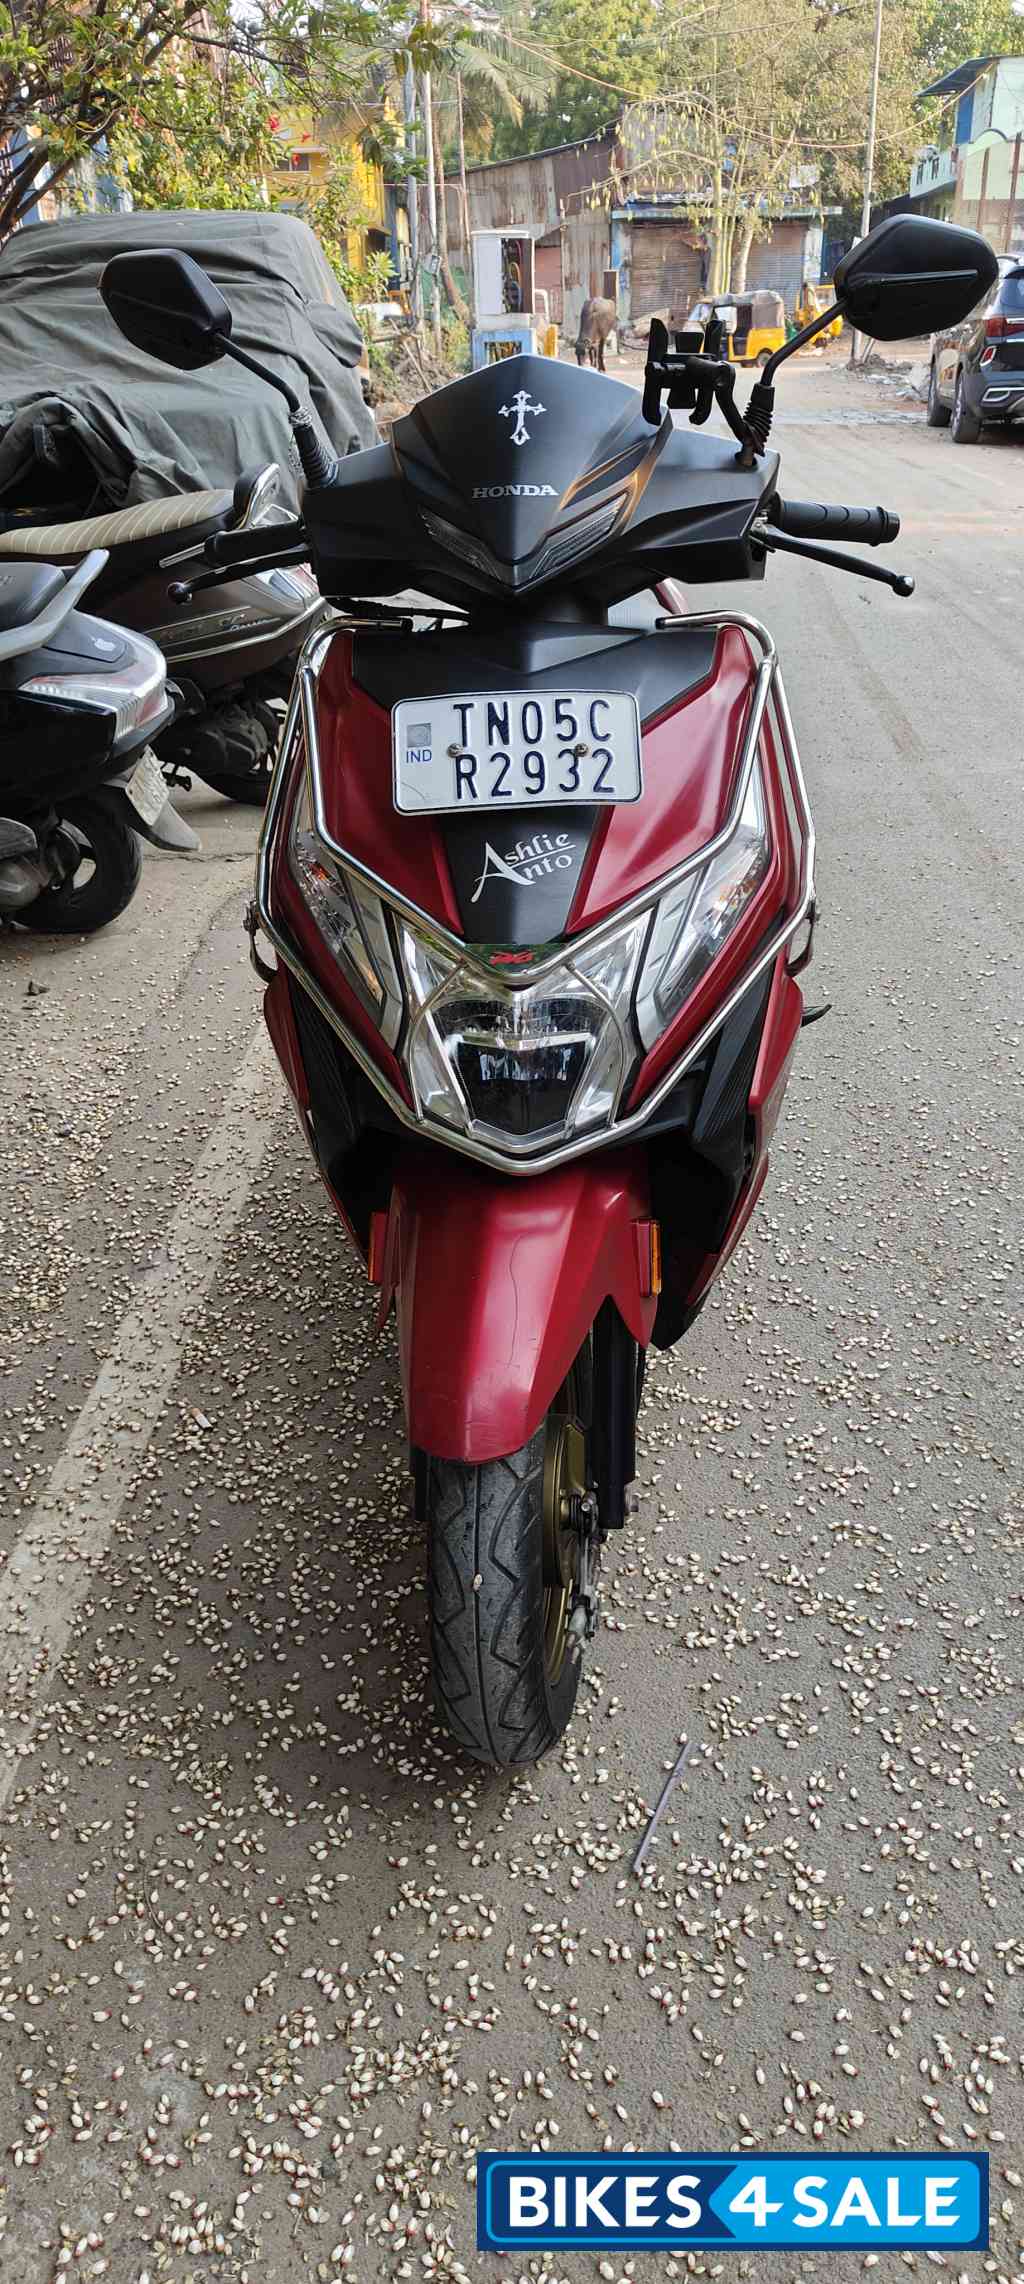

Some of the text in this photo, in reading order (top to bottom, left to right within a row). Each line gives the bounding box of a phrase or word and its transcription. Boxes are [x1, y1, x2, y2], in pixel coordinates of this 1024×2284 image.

[472, 485, 560, 499] HONDA
[453, 699, 612, 747] TN05C
[405, 749, 433, 764] IND
[455, 748, 615, 800] R2932
[471, 833, 575, 903] Ashlie
